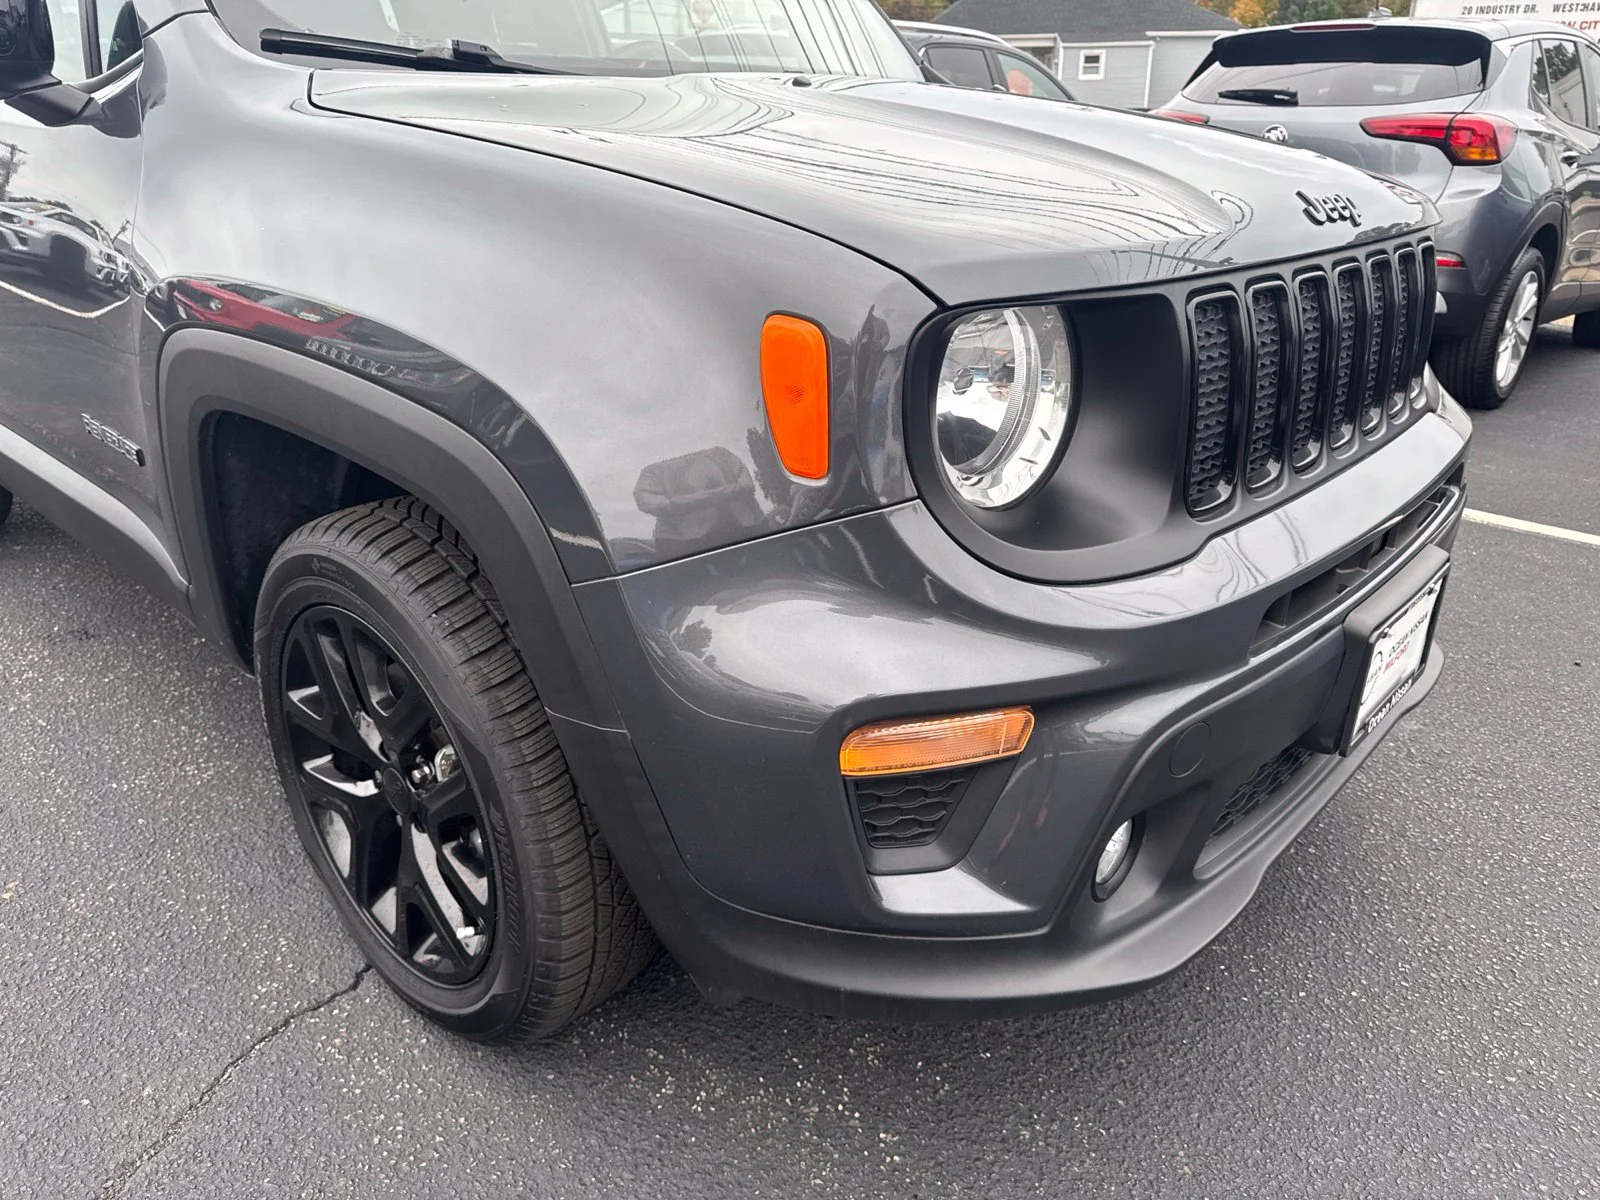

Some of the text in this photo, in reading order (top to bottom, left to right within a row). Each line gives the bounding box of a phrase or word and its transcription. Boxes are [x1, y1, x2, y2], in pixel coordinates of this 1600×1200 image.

[1461, 6, 1473, 15] 20
[1475, 4, 1521, 15] INDUSTRY
[1523, 4, 1539, 14] DR.
[1553, 3, 1580, 13] WEST
[1295, 190, 1361, 227] Jeep
[1368, 702, 1391, 733] Ocean
[1390, 678, 1413, 709] Nissan
